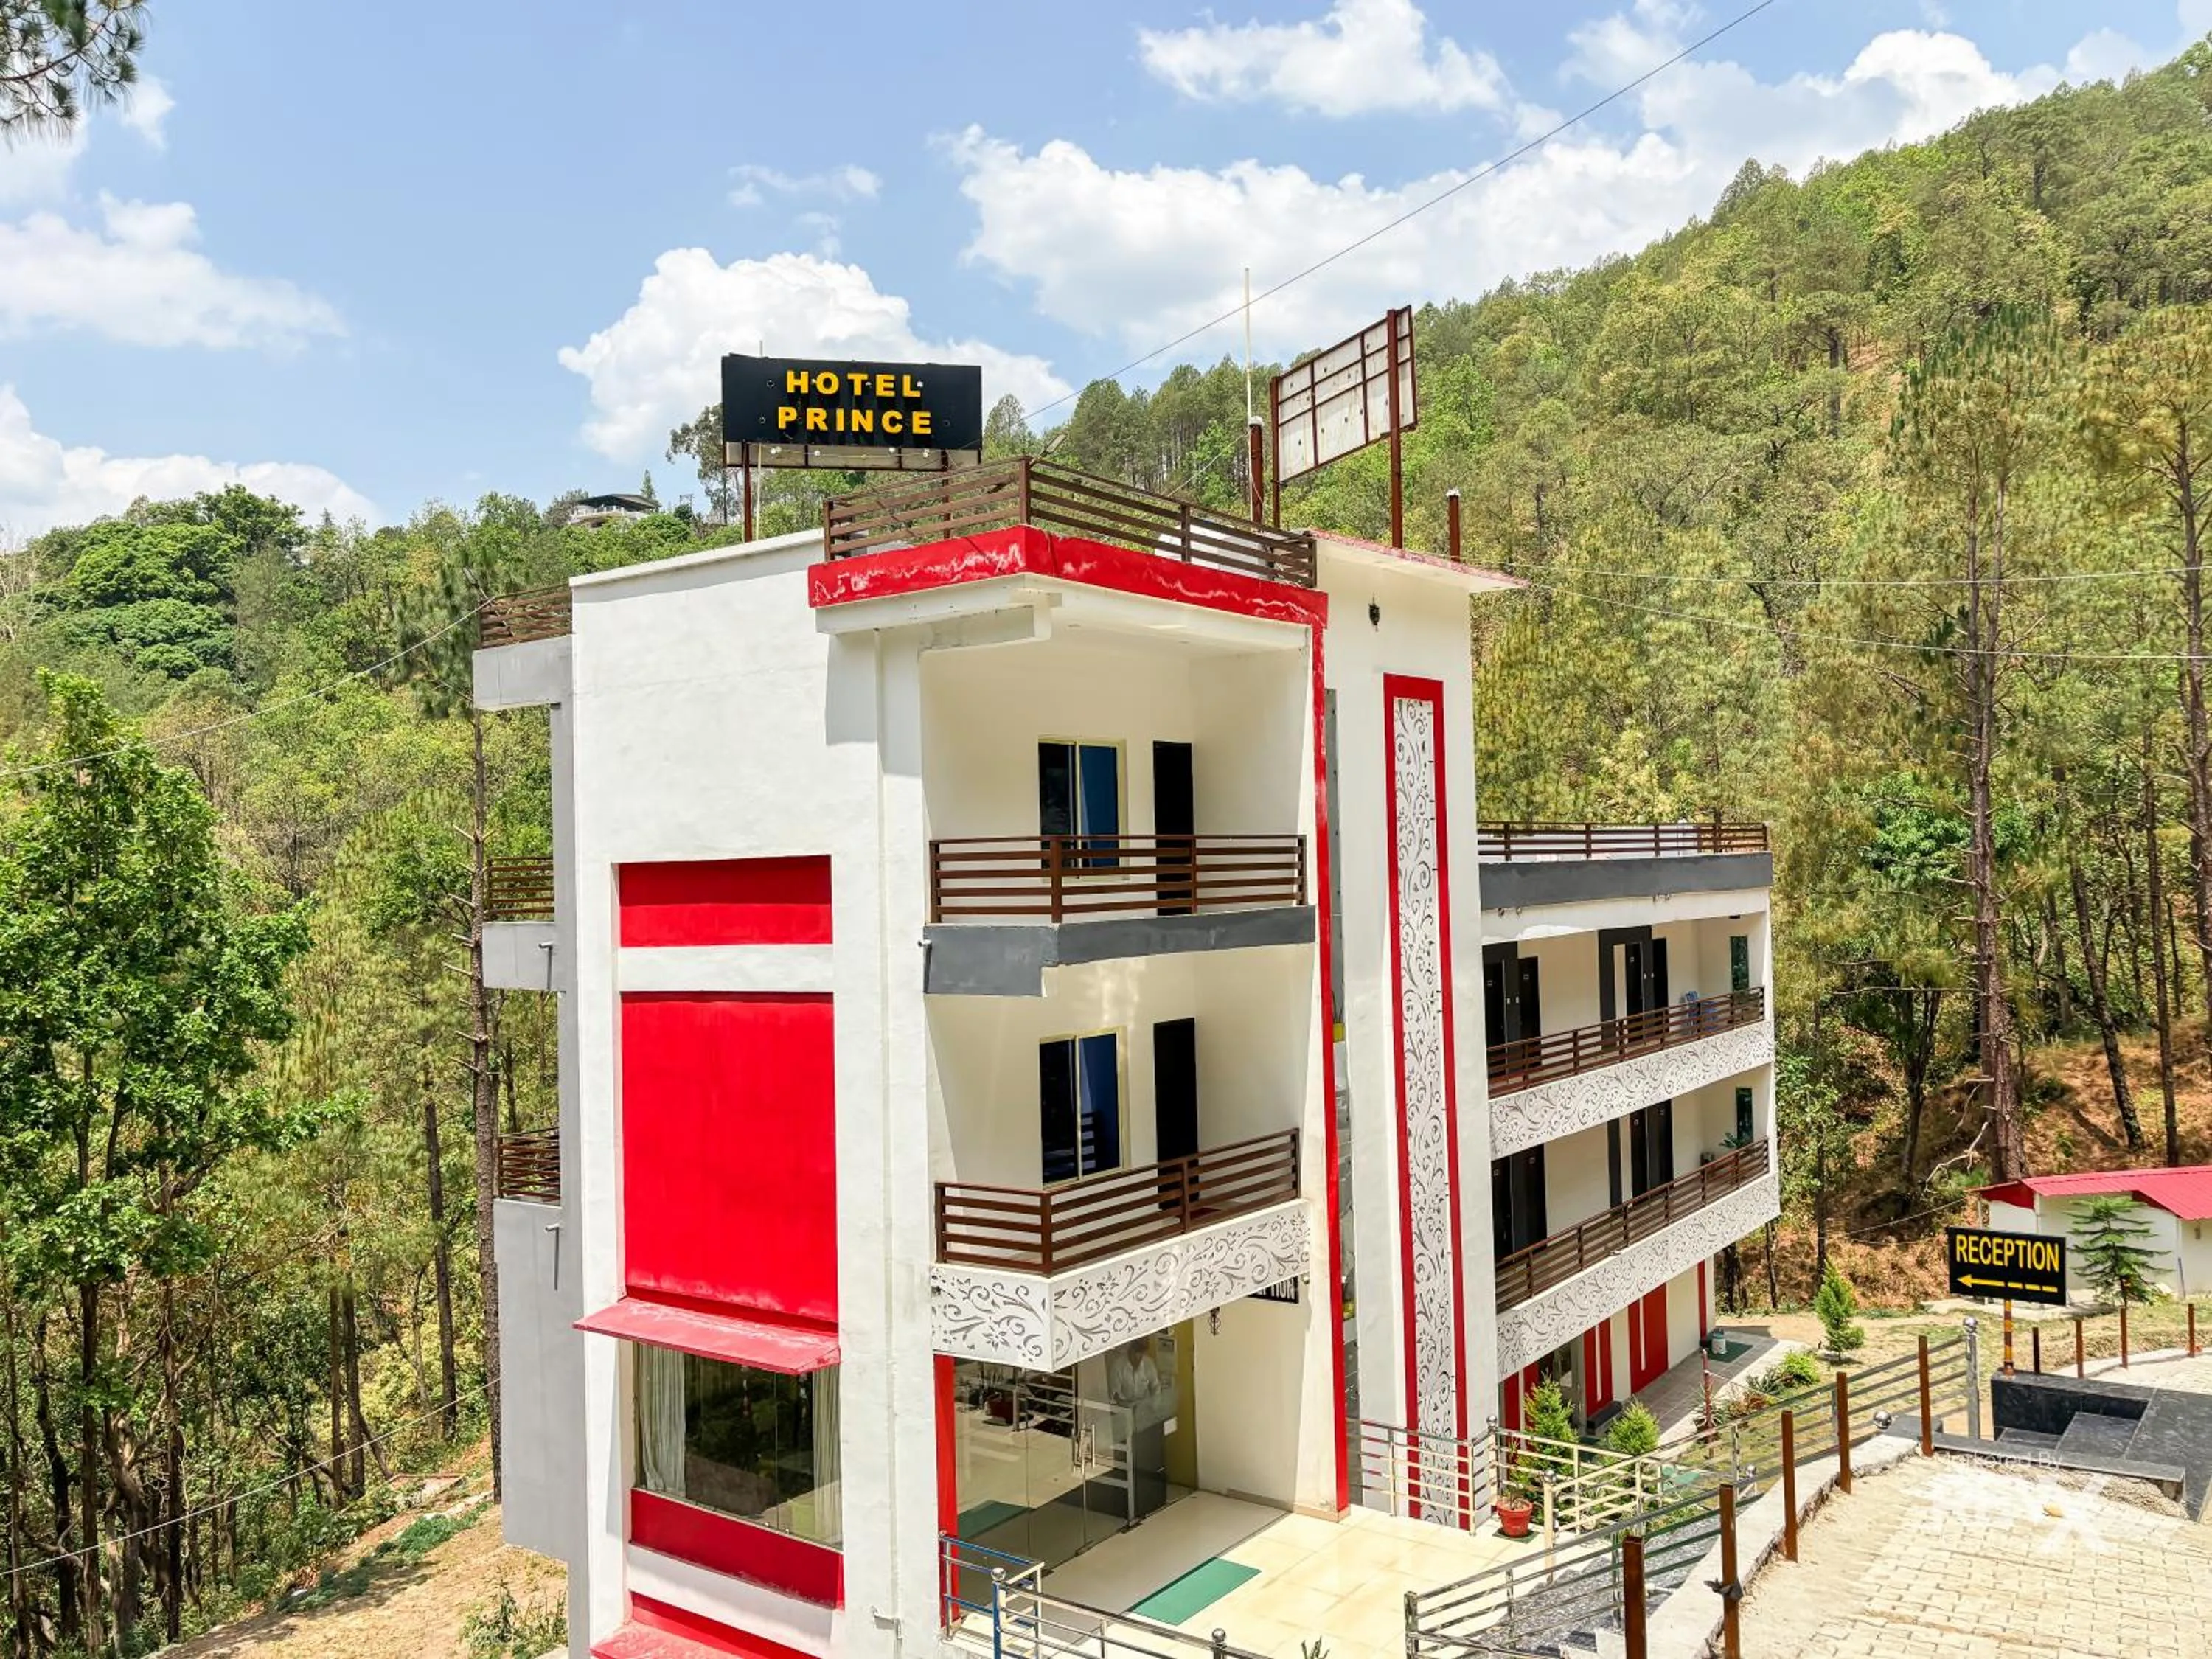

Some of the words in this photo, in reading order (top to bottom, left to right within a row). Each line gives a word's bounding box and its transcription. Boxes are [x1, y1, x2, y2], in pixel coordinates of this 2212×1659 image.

[786, 369, 921, 397] HOTEL
[778, 406, 932, 434] PRINCE
[1955, 1234, 2059, 1273] RECEPTION
